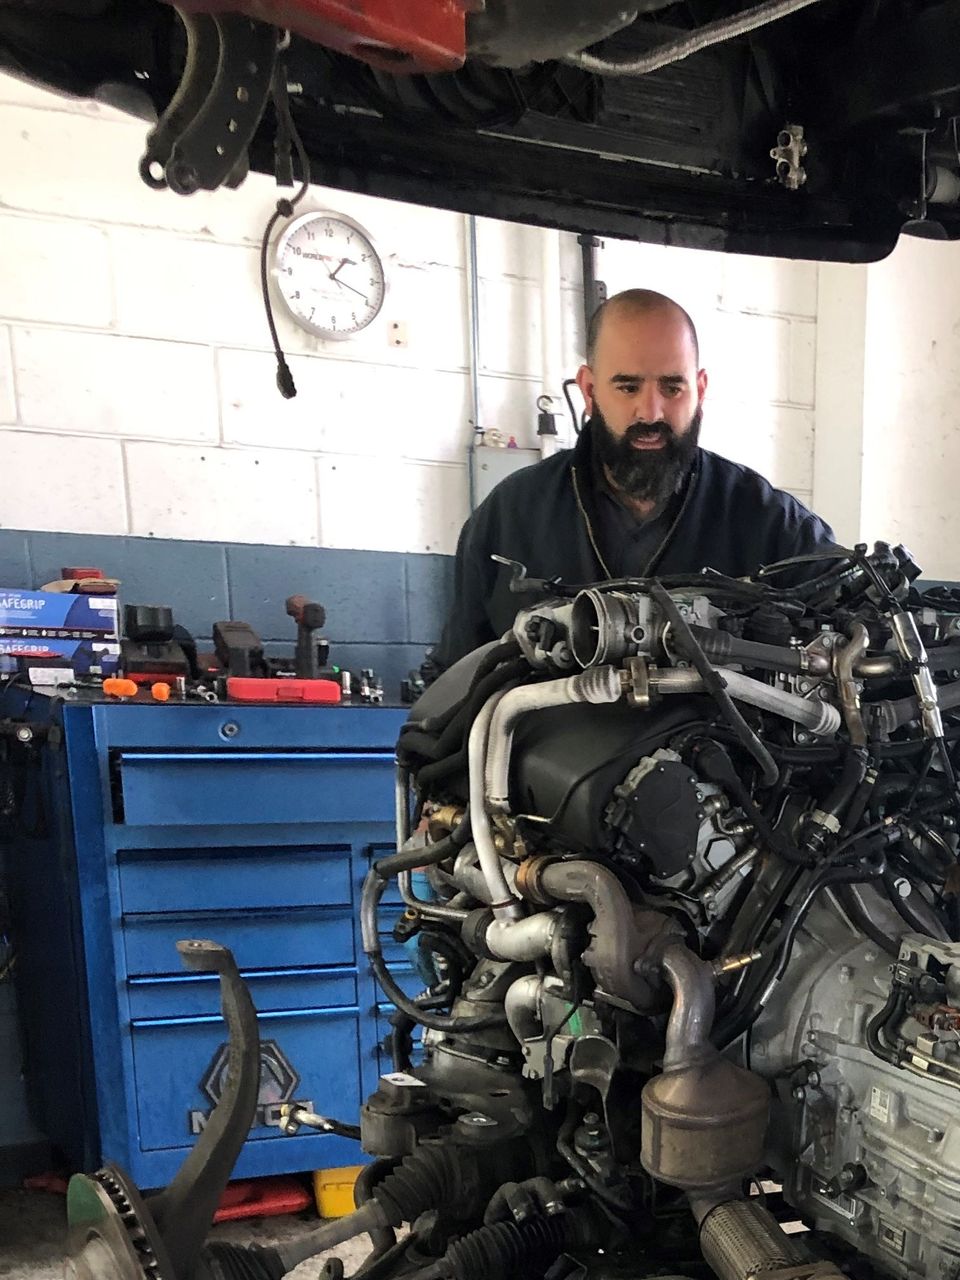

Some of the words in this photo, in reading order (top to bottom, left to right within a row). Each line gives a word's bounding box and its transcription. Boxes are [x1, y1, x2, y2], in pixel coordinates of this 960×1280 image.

[307, 231, 315, 240] 11
[325, 228, 334, 238] 12
[292, 246, 302, 255] 10
[361, 253, 367, 262] 2
[287, 267, 293, 276] 9
[369, 278, 375, 287] 3
[331, 315, 337, 324] 6
